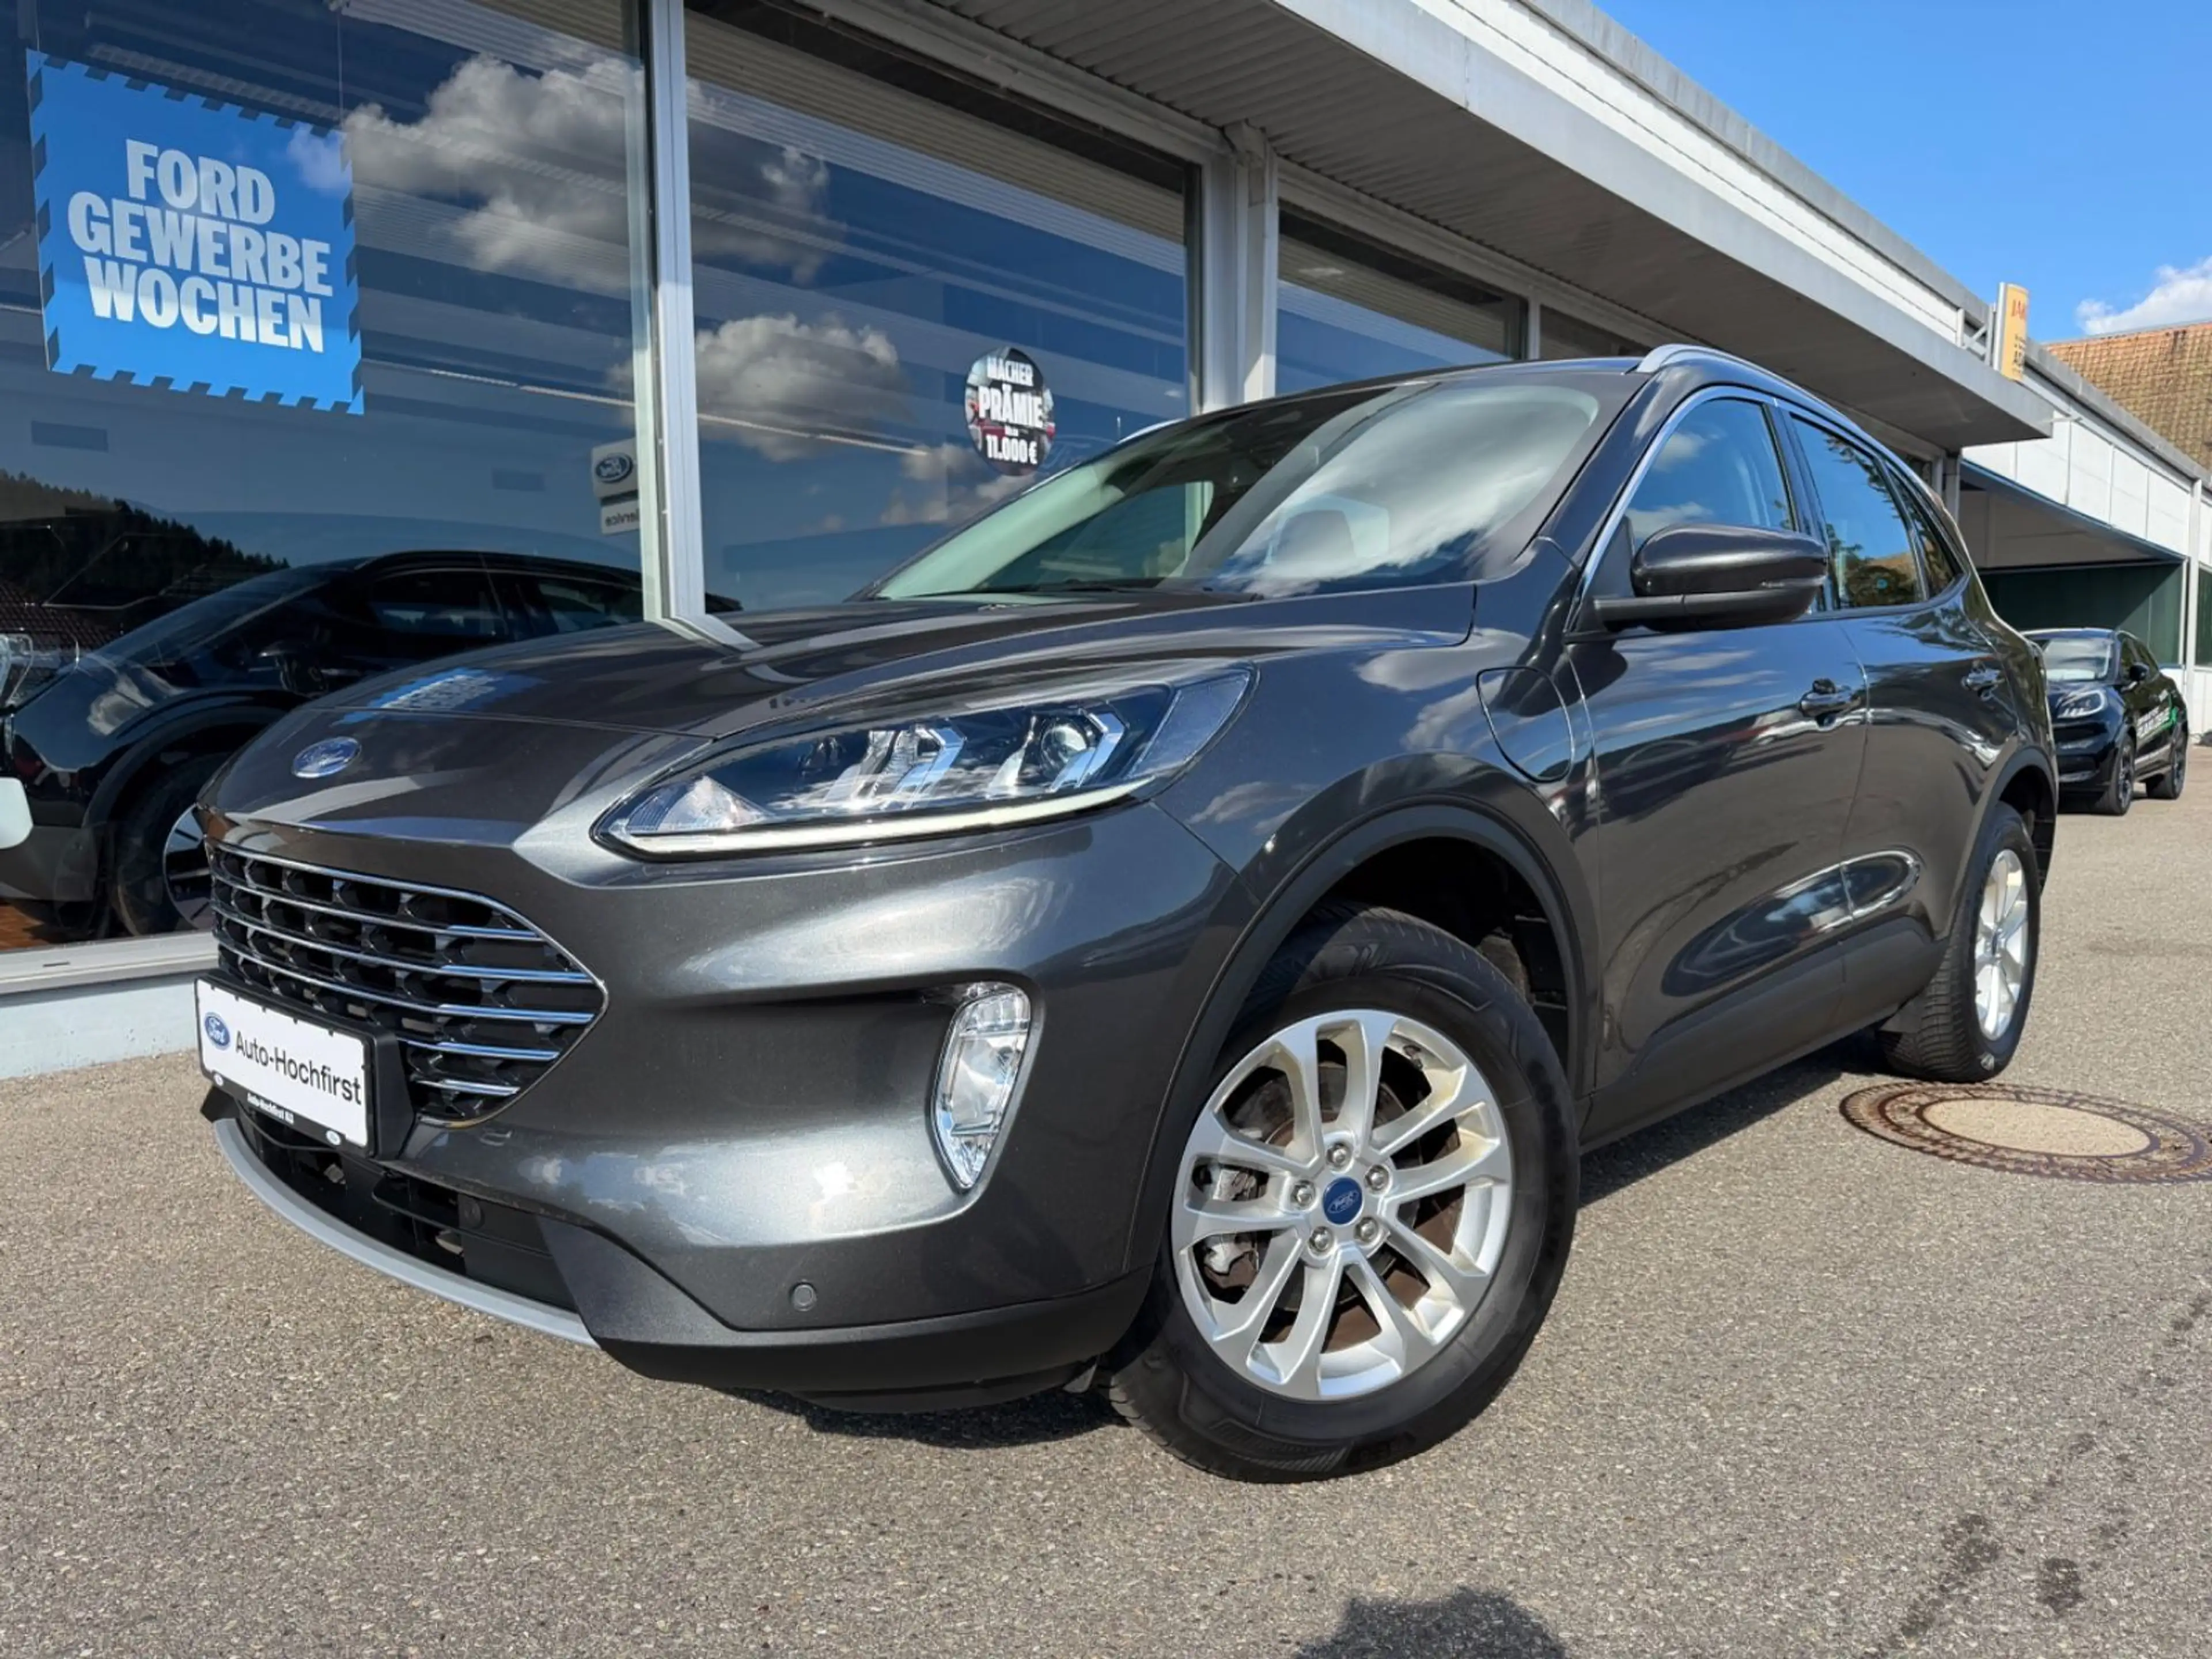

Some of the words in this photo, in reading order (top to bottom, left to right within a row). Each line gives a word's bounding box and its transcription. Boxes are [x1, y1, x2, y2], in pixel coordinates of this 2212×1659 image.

[126, 138, 275, 225] FORD
[67, 191, 333, 297] GEWERBE
[83, 256, 324, 353] WOCHEN
[978, 383, 1043, 428] PRÄMIE
[987, 355, 1034, 387] MACHER
[236, 1030, 362, 1105] Auto-Hochfirst
